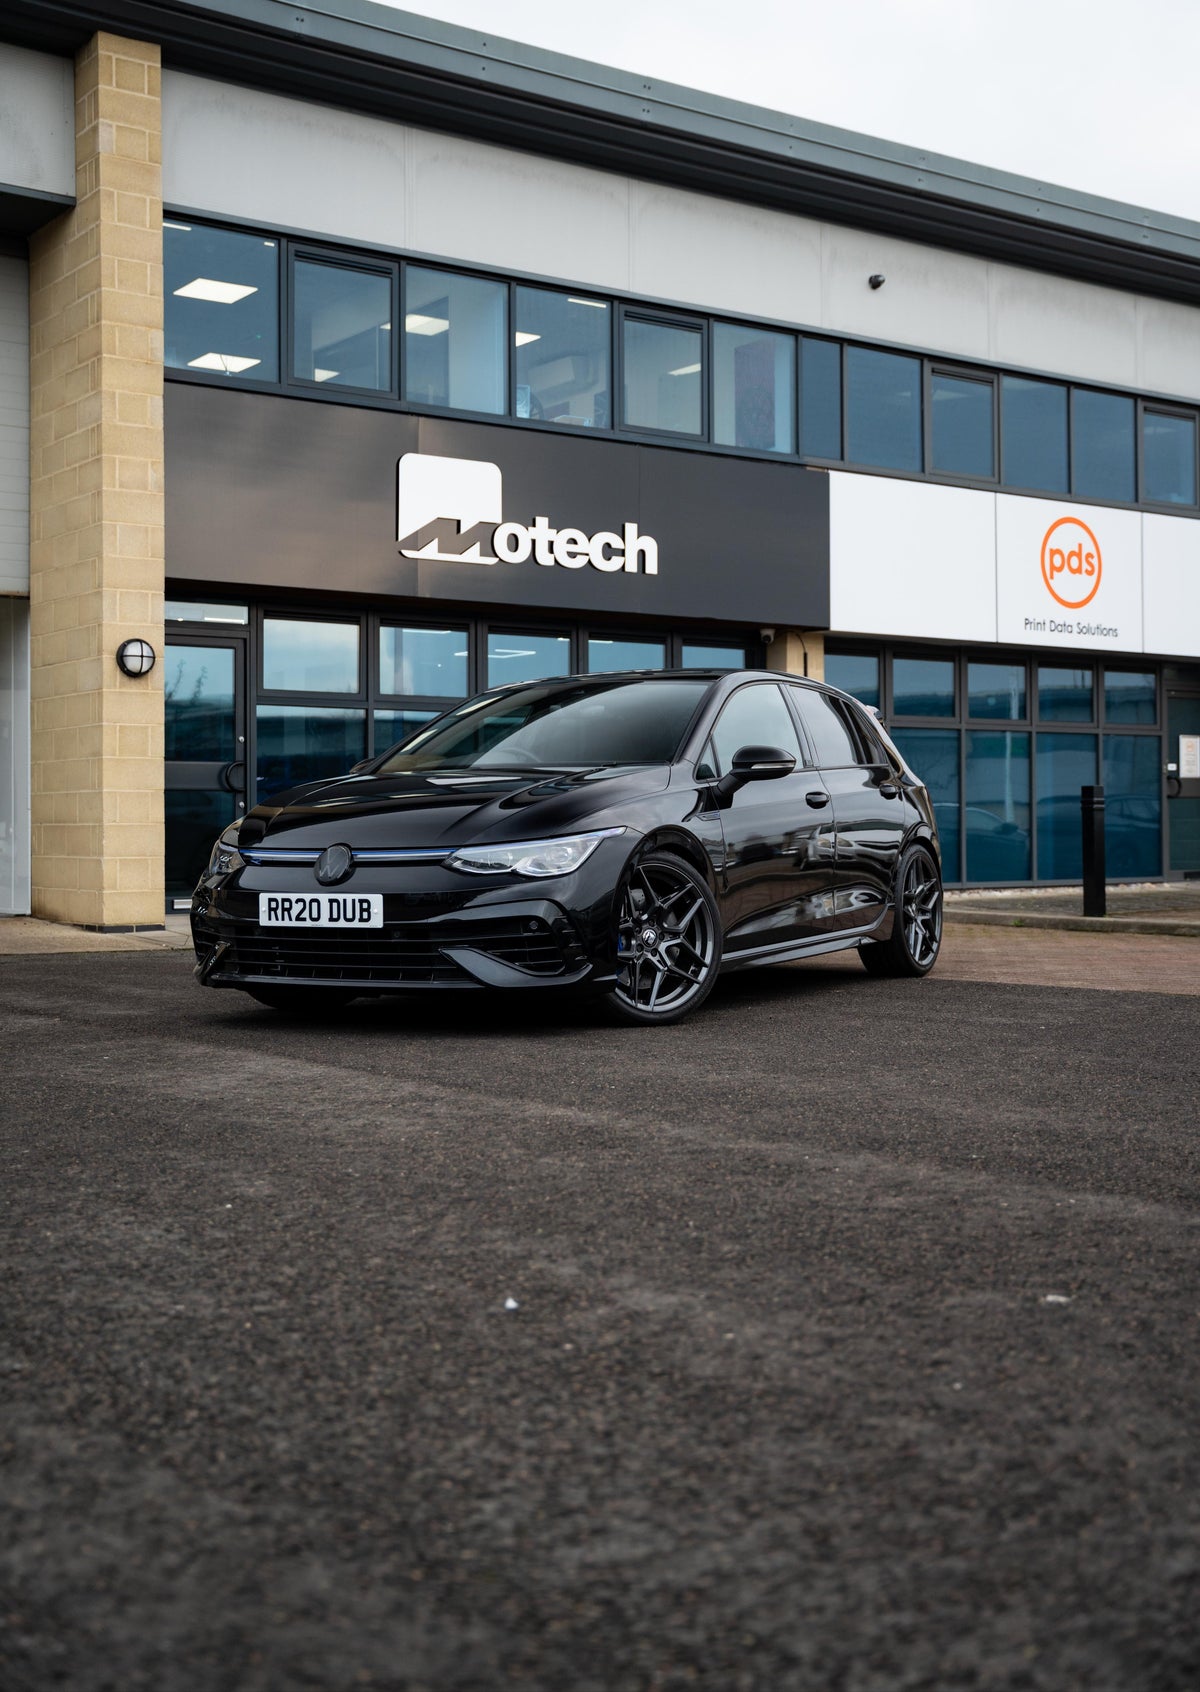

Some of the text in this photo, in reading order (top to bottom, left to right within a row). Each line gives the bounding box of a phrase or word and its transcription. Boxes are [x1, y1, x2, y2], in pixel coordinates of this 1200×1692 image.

[397, 453, 658, 576] Motech
[1049, 544, 1095, 579] pds
[1024, 618, 1118, 637] Print Data Solutions
[267, 897, 371, 923] RR20 DUB
